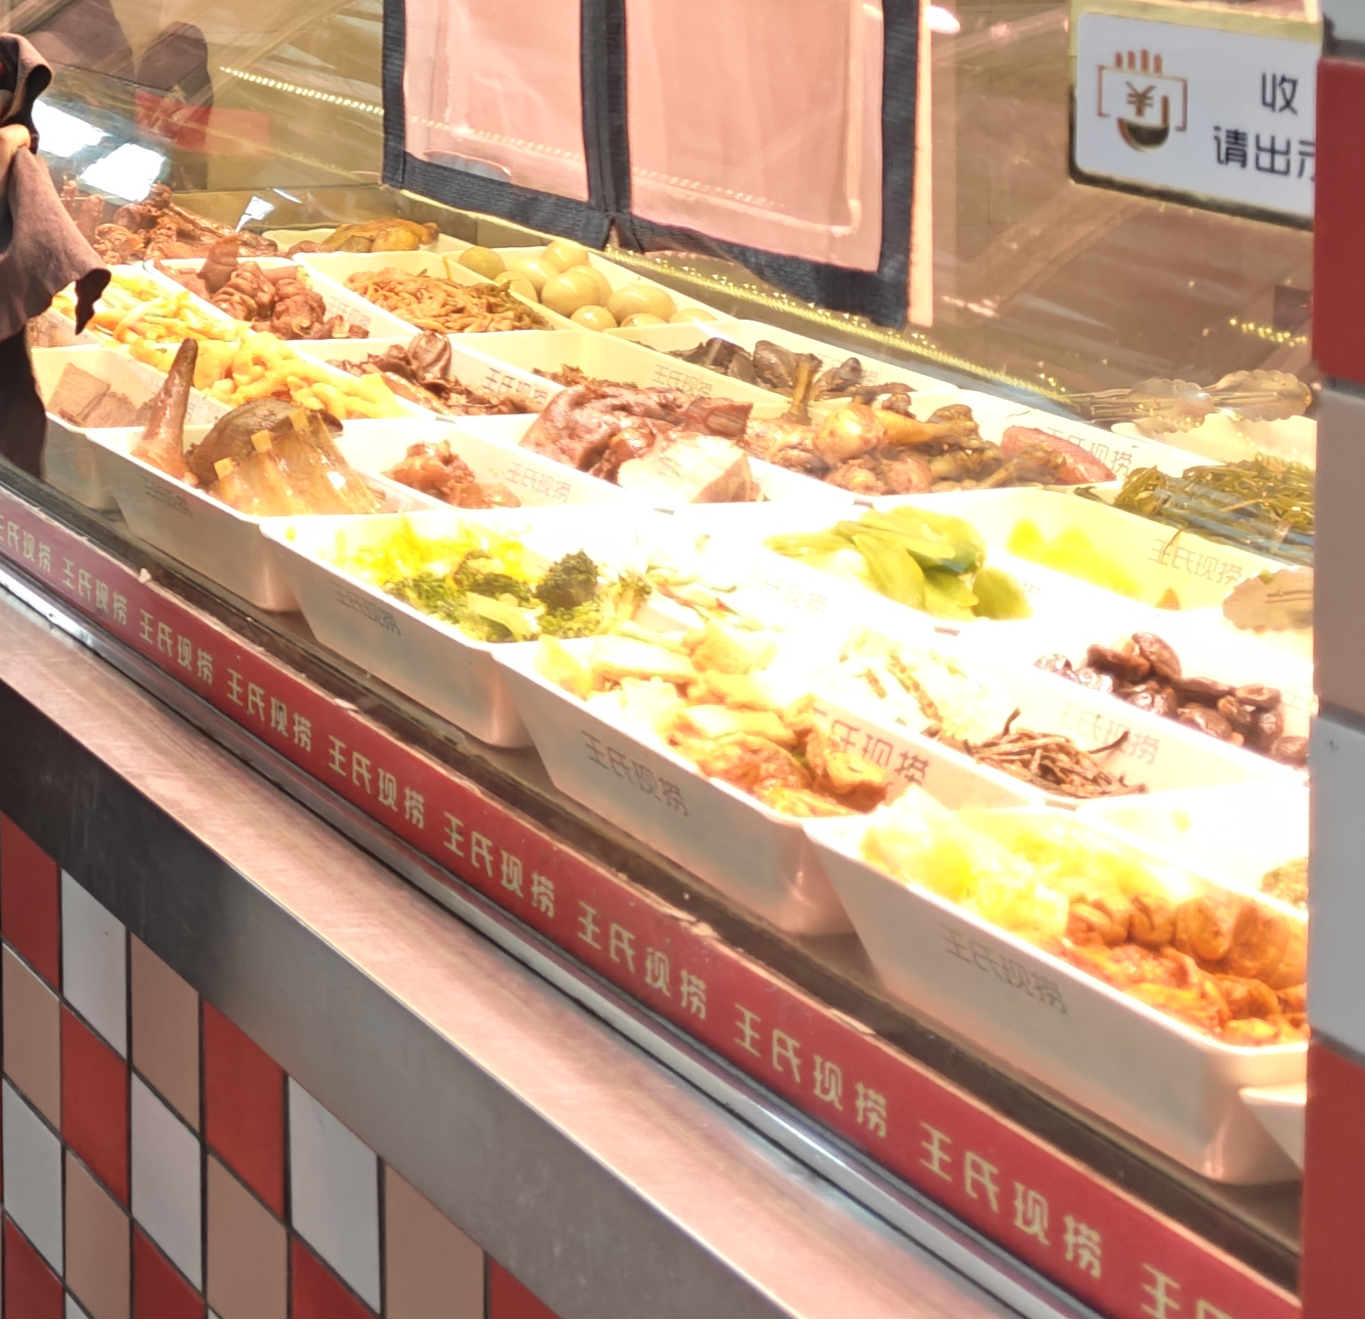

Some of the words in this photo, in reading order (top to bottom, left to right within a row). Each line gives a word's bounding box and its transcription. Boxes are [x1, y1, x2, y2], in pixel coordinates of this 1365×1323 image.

[1262, 71, 1299, 117] 收
[1148, 538, 1243, 586] 王氏现捞
[581, 730, 690, 818] 王氏现捞
[812, 706, 930, 787] 氏现捞
[61, 556, 128, 627] 王氏现捞
[138, 607, 214, 686] 王氏现捞
[226, 667, 313, 754] 王氏现捞
[327, 733, 426, 830] 王氏现捞
[441, 810, 556, 919] 王氏现捞
[576, 900, 708, 1021] 王氏现捞
[733, 1002, 889, 1140] 王氏现捞
[918, 1120, 1103, 1280] 王氏现捞
[937, 924, 1069, 1016] 王氏现捞
